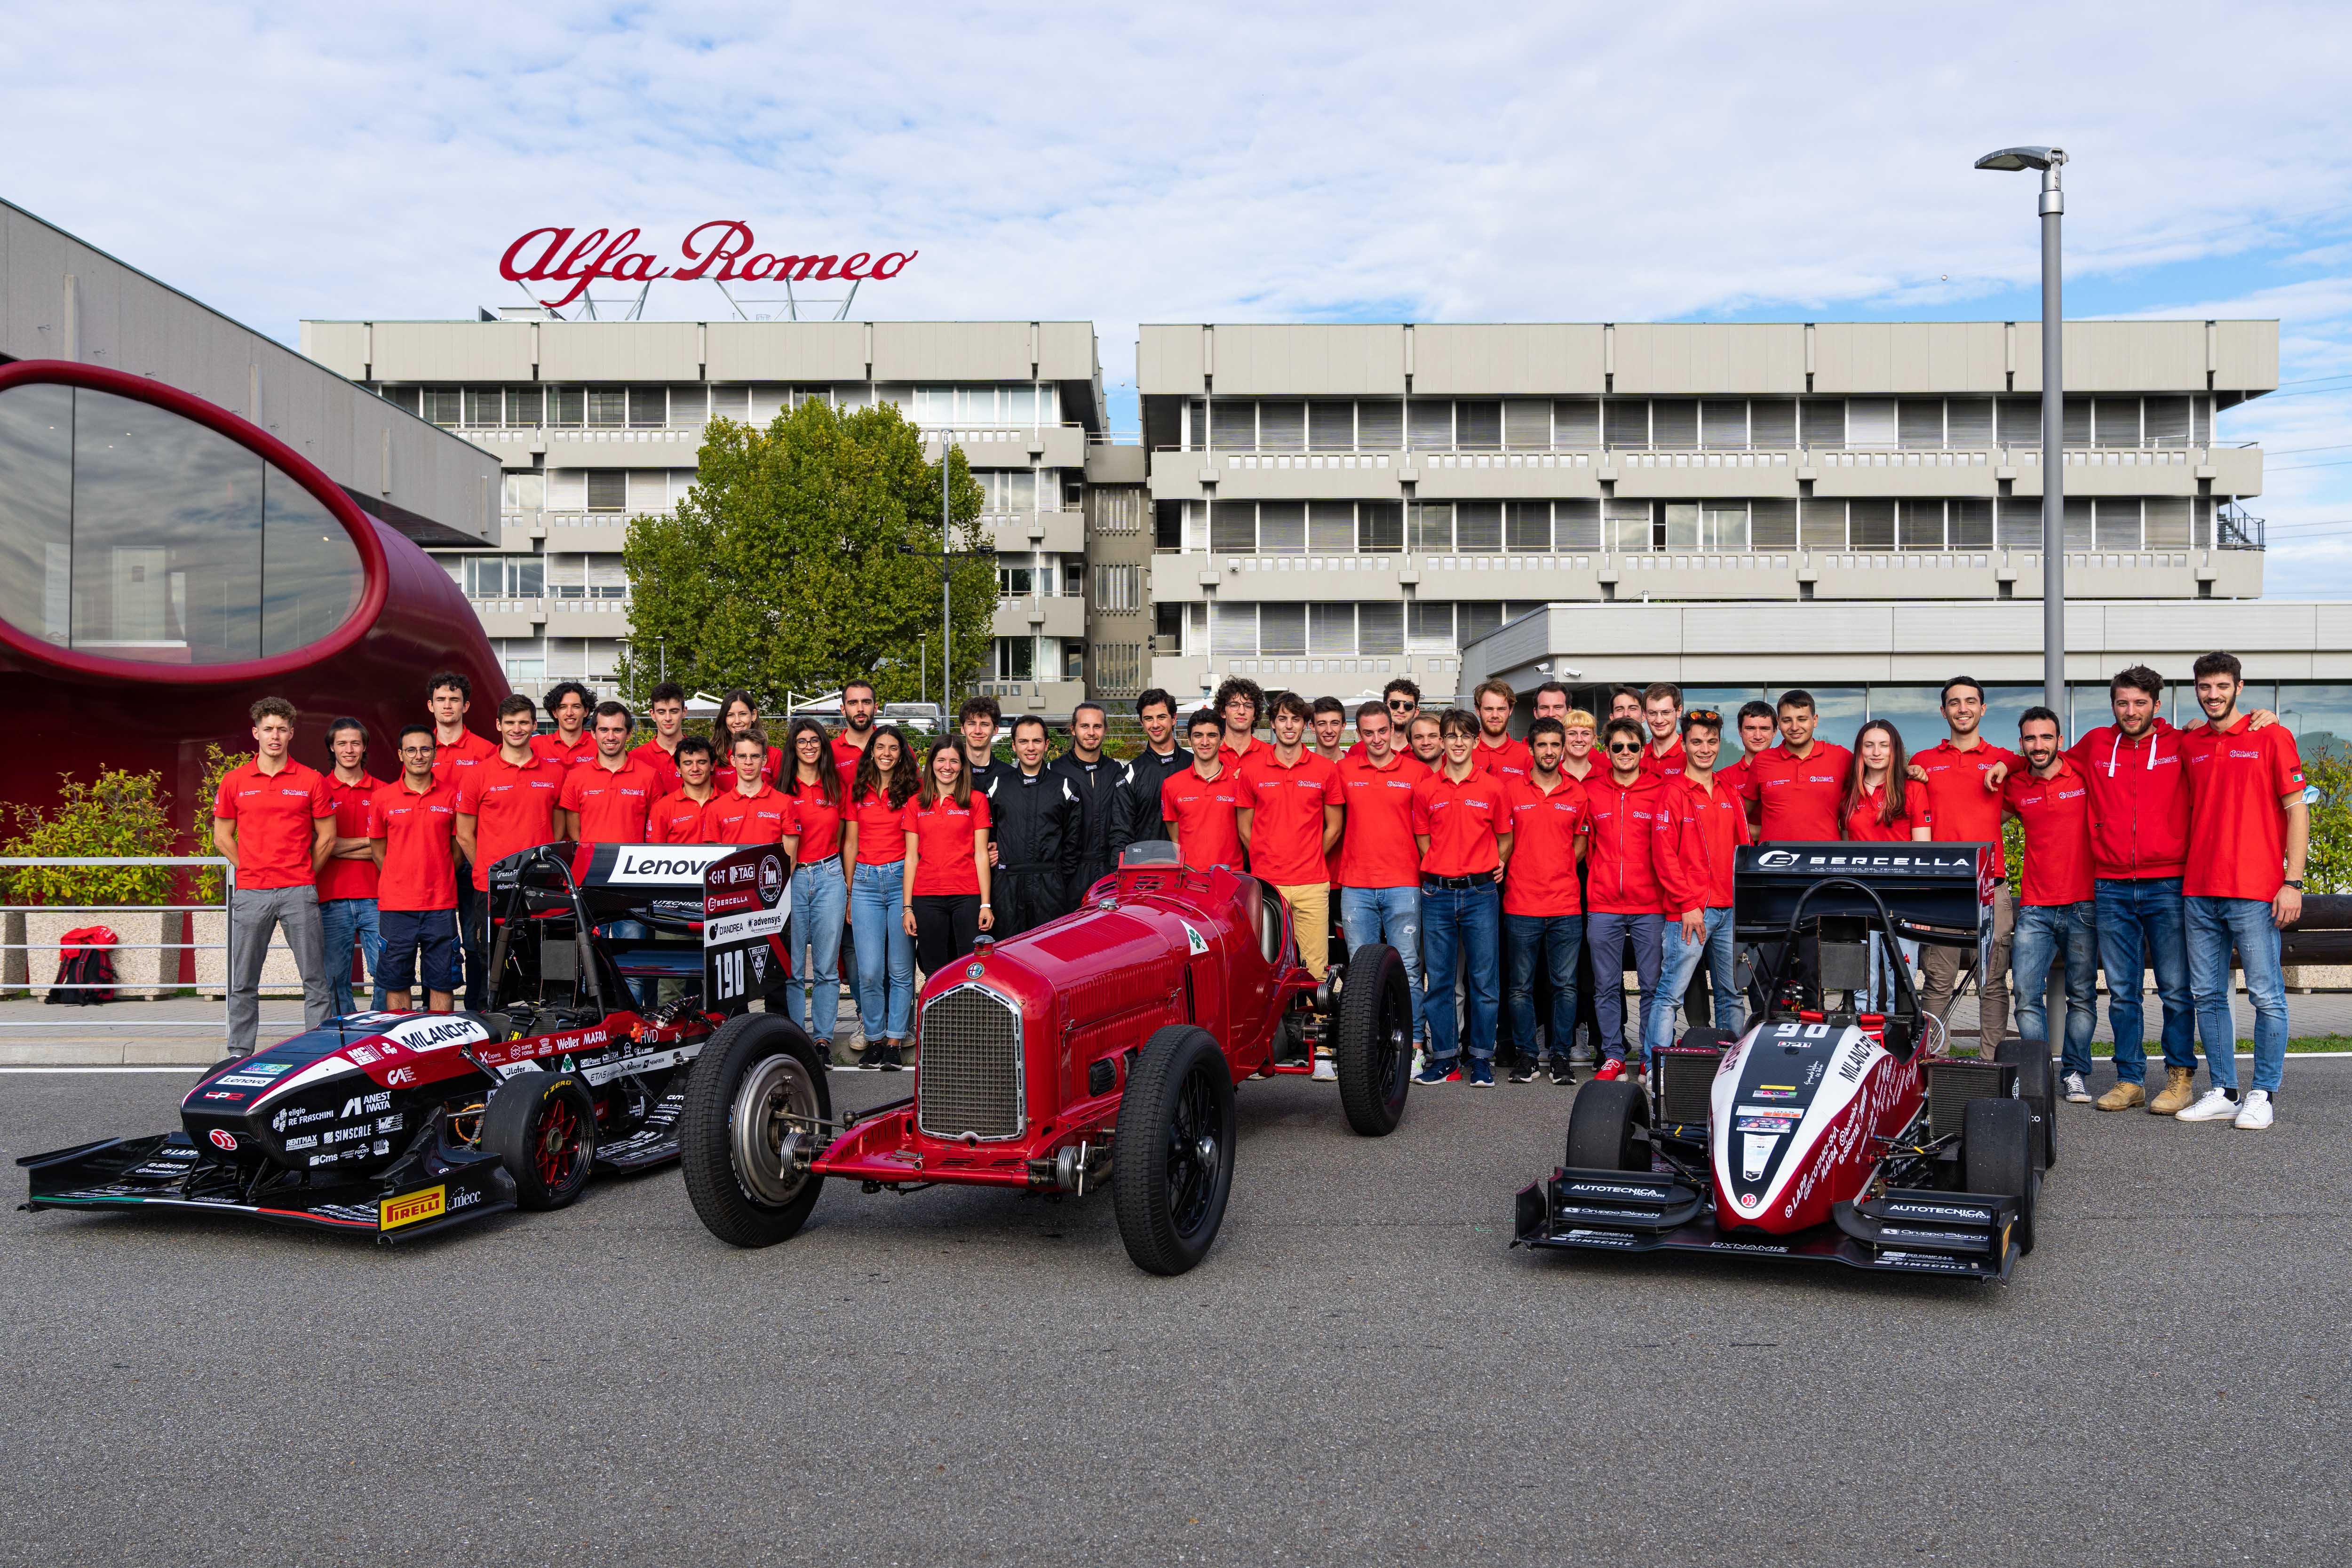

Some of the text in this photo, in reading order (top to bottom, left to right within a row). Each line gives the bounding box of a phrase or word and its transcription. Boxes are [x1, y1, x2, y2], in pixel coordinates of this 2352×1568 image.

[499, 220, 918, 307] Alfa Romeo
[623, 855, 717, 875] Lenov
[1810, 857, 1970, 866] BERCELLA
[497, 870, 513, 879] Grazie
[739, 866, 754, 879] TAG
[653, 899, 703, 908] LITECNICO
[717, 896, 748, 907] BERCELLA
[754, 915, 781, 927] advensys
[720, 923, 743, 935] D'ANDREA
[715, 949, 744, 1000] 190
[640, 1028, 658, 1044] HVD
[1773, 1023, 1831, 1038] 90
[556, 1037, 579, 1050] Weller
[583, 1030, 607, 1045] MAFRA
[511, 1065, 525, 1075] Lafer
[590, 1070, 607, 1081] ETAS
[544, 1080, 572, 1101] P ZERO
[363, 1091, 391, 1105] ANEST
[288, 1107, 306, 1117] eligio
[366, 1101, 391, 1113] IWATA
[288, 1110, 334, 1126] RE FRASCHINI
[1844, 1102, 1858, 1136] brembo
[334, 1124, 372, 1142] SIMSCALE
[286, 1134, 318, 1146] RENTMAX
[1843, 1123, 1860, 1157] sisma
[355, 1147, 370, 1155] FUCHS
[319, 1154, 338, 1163] Cms
[1821, 1144, 1838, 1183] MAFRA
[1571, 1184, 1657, 1194] AUTOTECNICA
[1804, 1167, 1818, 1201] GEICO
[1792, 1173, 1807, 1210] LAPP
[453, 1191, 481, 1208] mecc
[387, 1192, 440, 1223] PIRELLI
[1889, 1205, 1986, 1216] AUTOTECNICA
[1568, 1238, 1633, 1246] SIMSCALE
[1944, 1233, 1989, 1241] Bianchi
